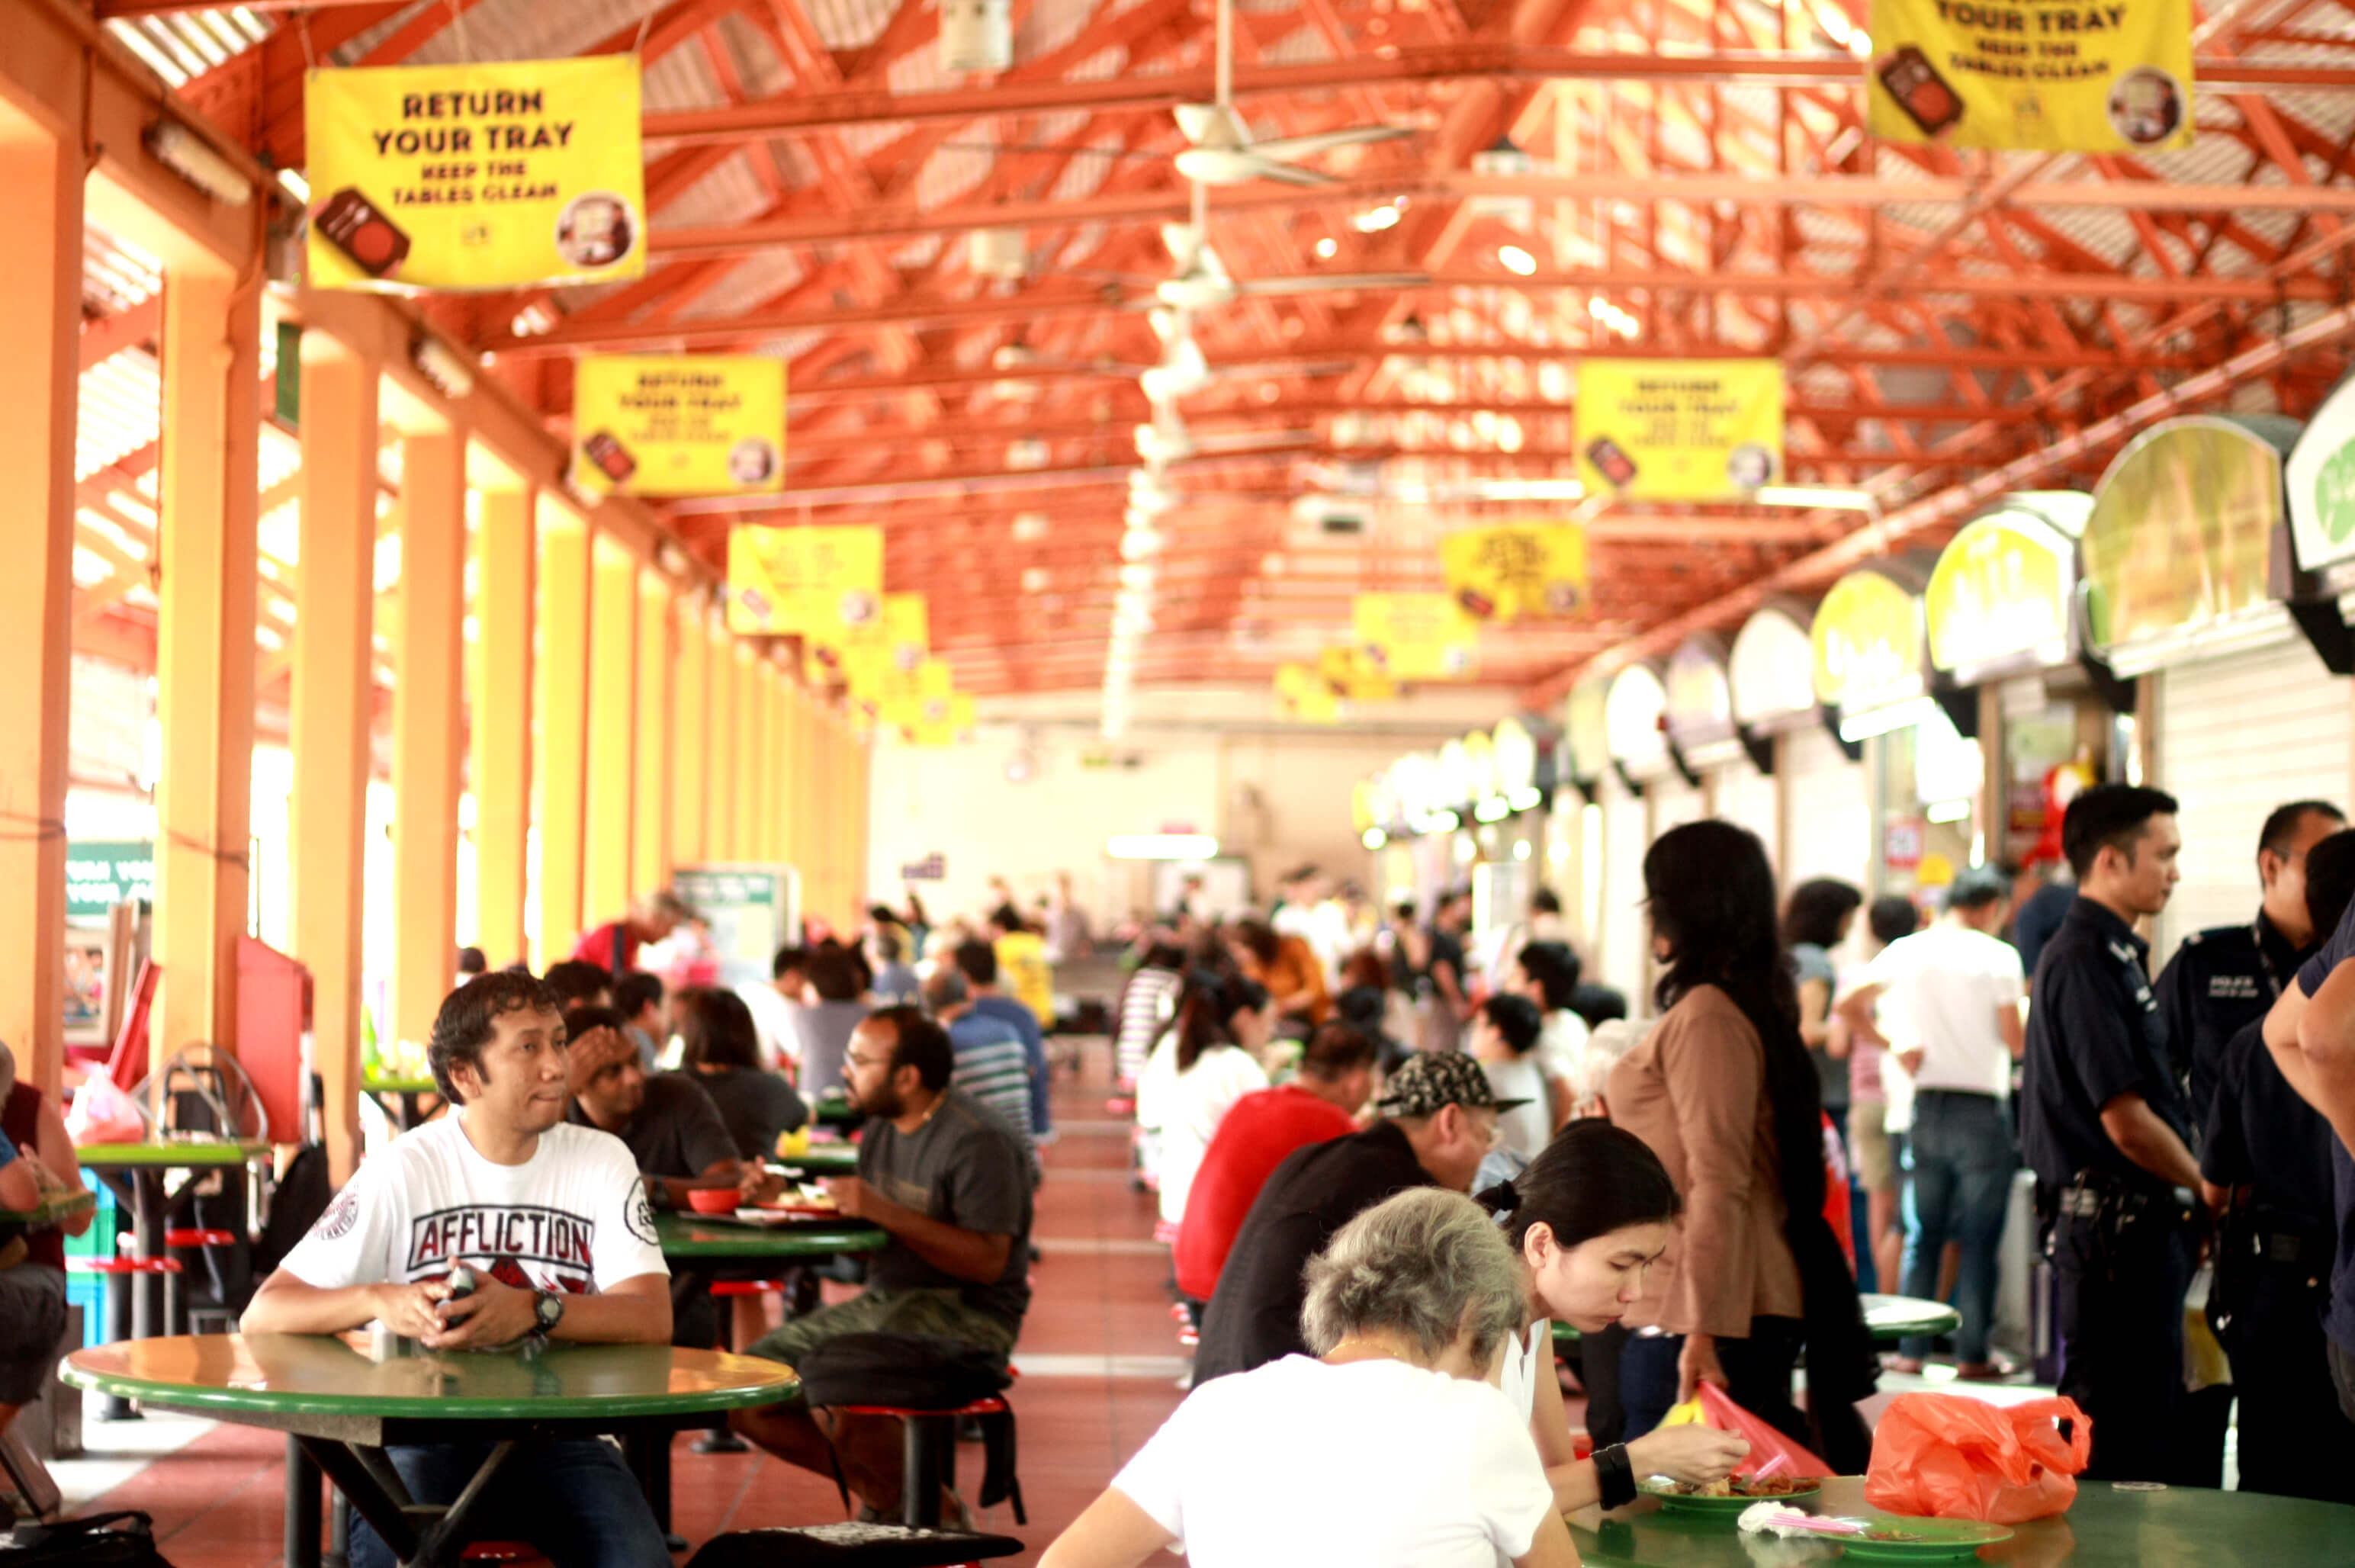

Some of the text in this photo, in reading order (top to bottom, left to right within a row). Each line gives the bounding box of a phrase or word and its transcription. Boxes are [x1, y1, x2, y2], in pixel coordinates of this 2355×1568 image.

[1938, 0, 2125, 31] YOUR TRAY
[403, 88, 544, 119] RETURN
[373, 120, 573, 156] YOUR TRAY
[422, 160, 526, 180] KEEP THE
[394, 183, 557, 204] TABLES CLEAN
[418, 1212, 591, 1264] AFFLICTION
